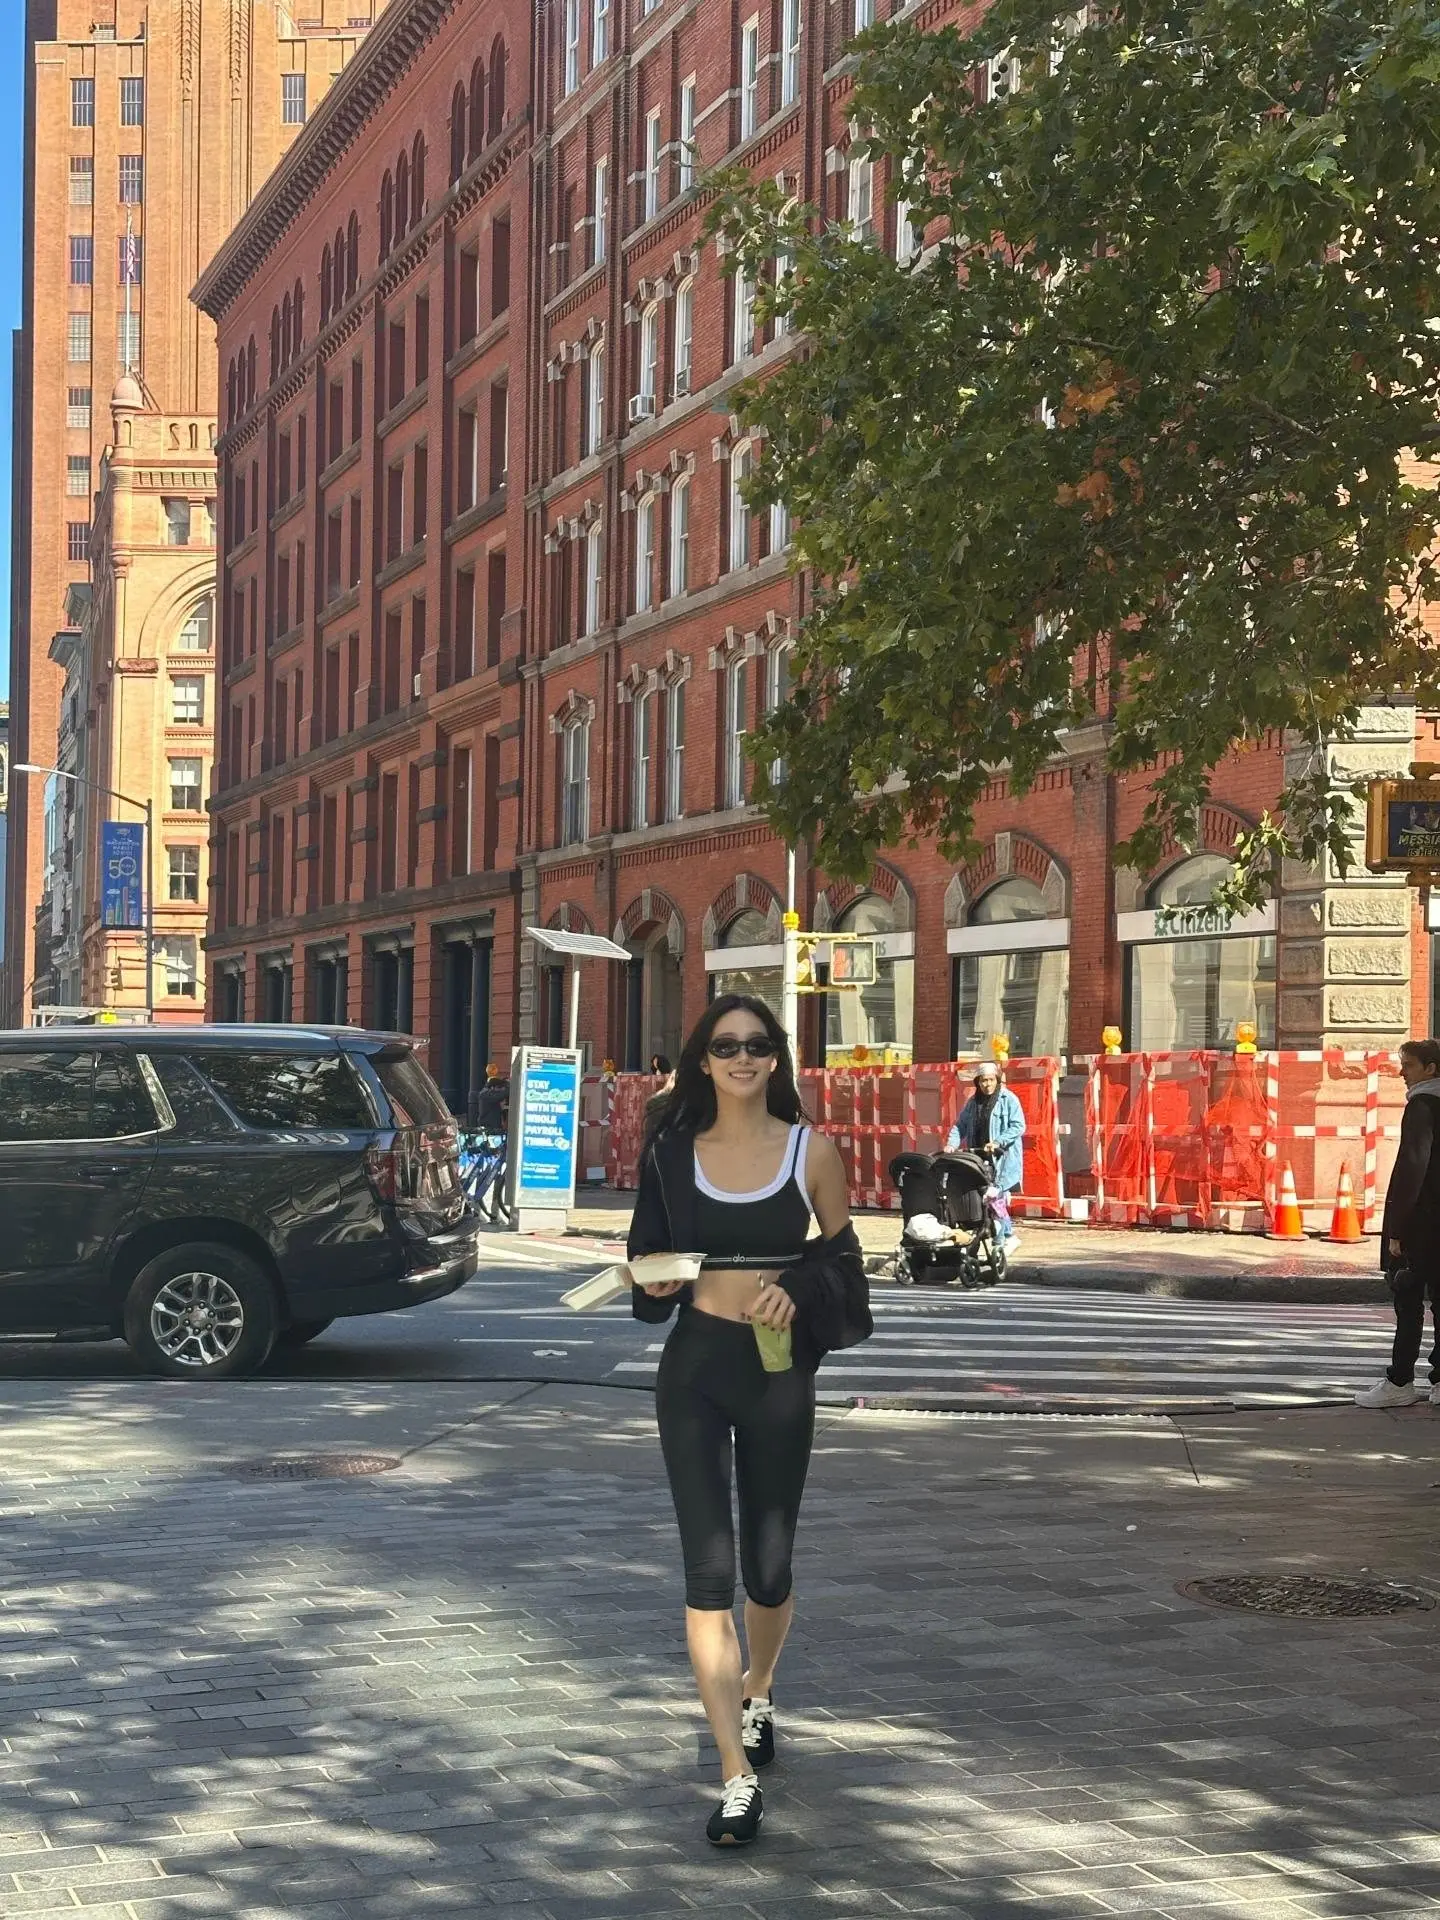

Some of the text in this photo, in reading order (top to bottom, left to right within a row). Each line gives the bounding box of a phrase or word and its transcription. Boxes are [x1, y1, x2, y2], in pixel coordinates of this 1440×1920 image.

[109, 856, 136, 878] 50
[528, 1080, 549, 1089] STAY
[526, 1103, 549, 1112] WITH
[525, 1114, 556, 1124] WHOLE
[525, 1126, 564, 1136] PAYROLL
[732, 1252, 746, 1263] alo
